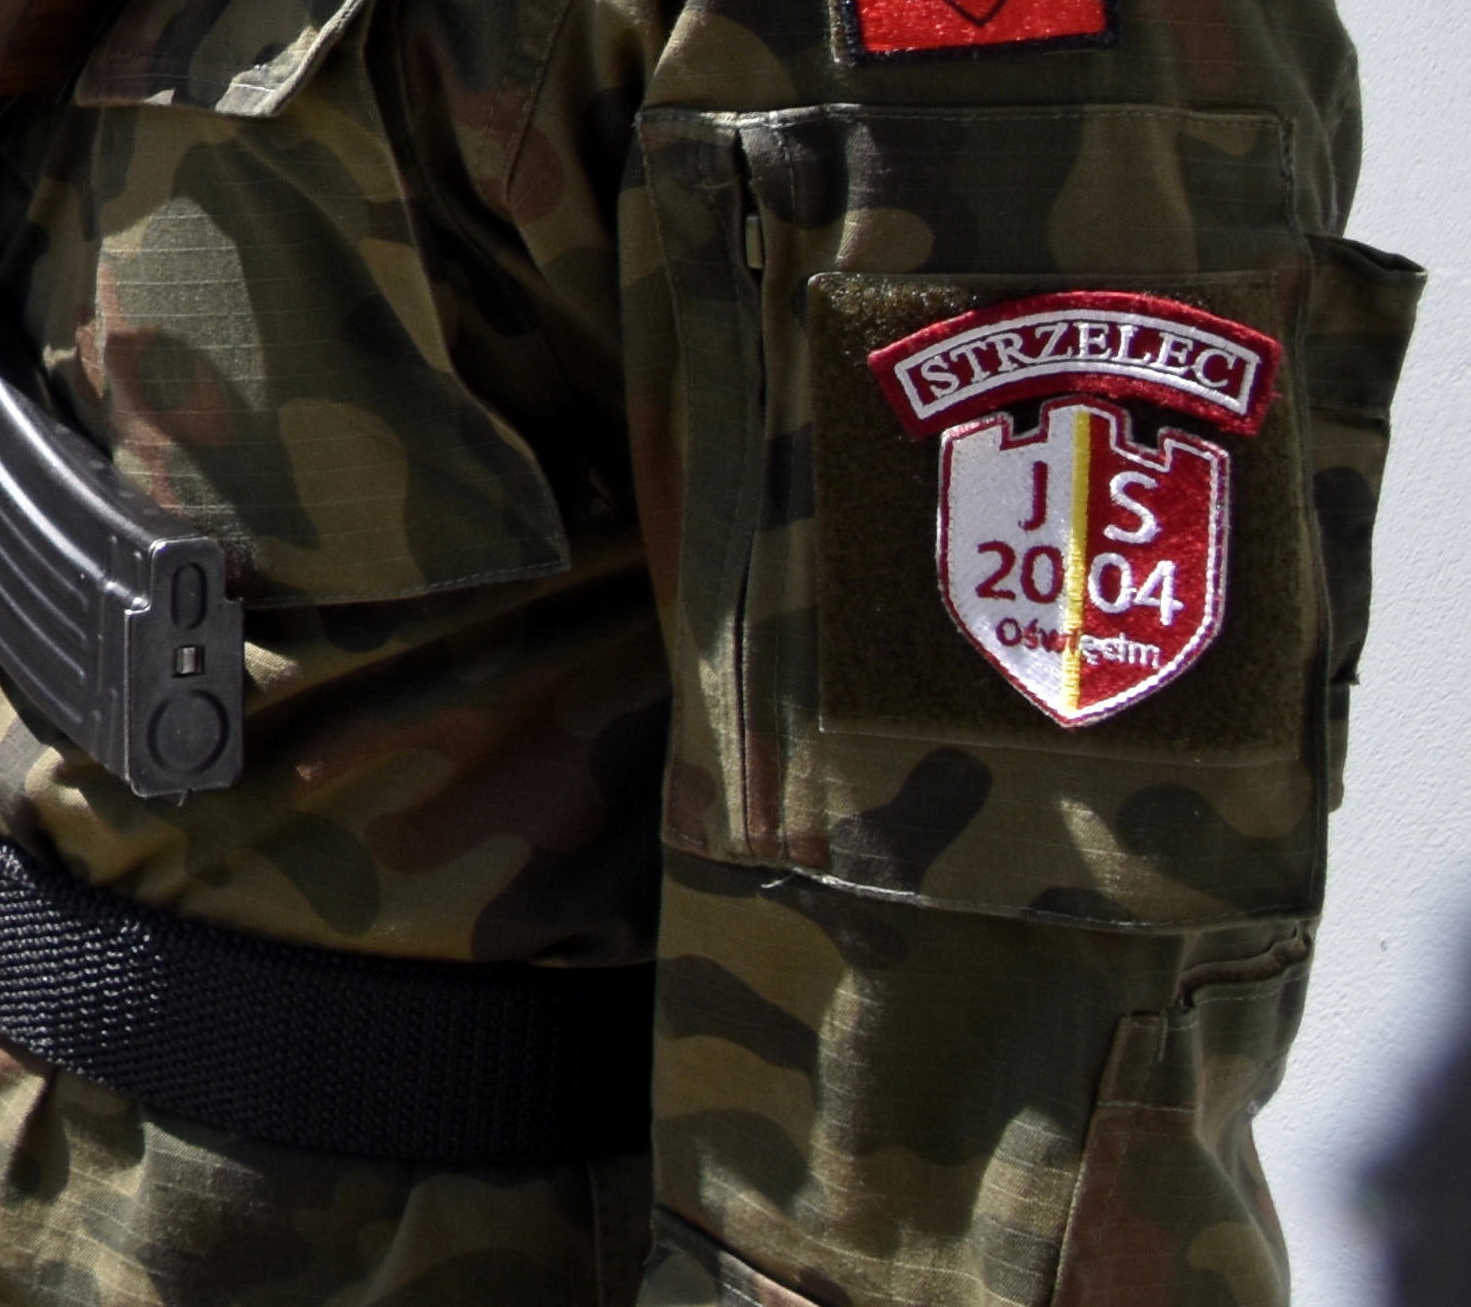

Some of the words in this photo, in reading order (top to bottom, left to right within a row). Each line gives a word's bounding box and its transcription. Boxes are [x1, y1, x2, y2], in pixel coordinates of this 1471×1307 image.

[918, 319, 1238, 399] STRZELEC
[1017, 460, 1049, 531] J
[1103, 470, 1163, 545] S
[995, 616, 1162, 669] Oświęcim
